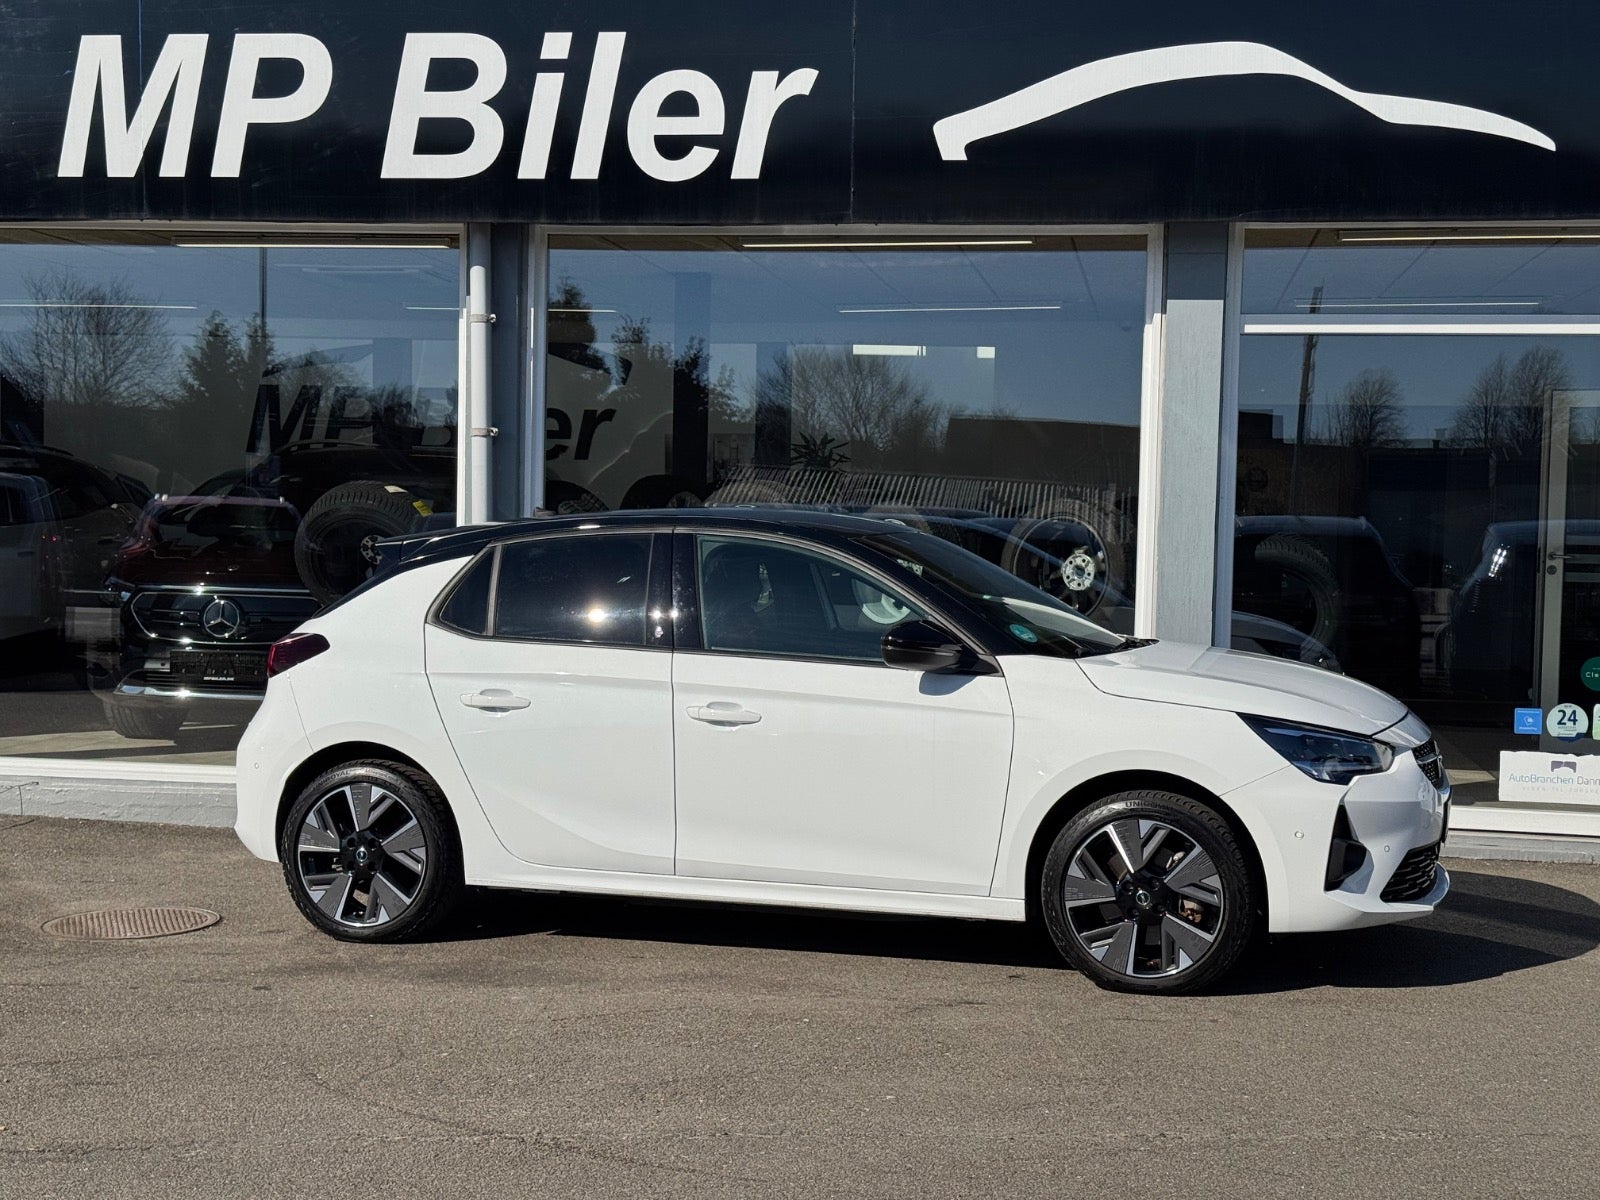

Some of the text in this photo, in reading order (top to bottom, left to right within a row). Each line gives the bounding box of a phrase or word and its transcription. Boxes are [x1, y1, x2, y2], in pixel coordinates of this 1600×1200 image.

[58, 31, 819, 182] MP Biler
[245, 384, 374, 453] MP
[1557, 709, 1578, 726] 24
[1508, 773, 1574, 785] AutoBranchen
